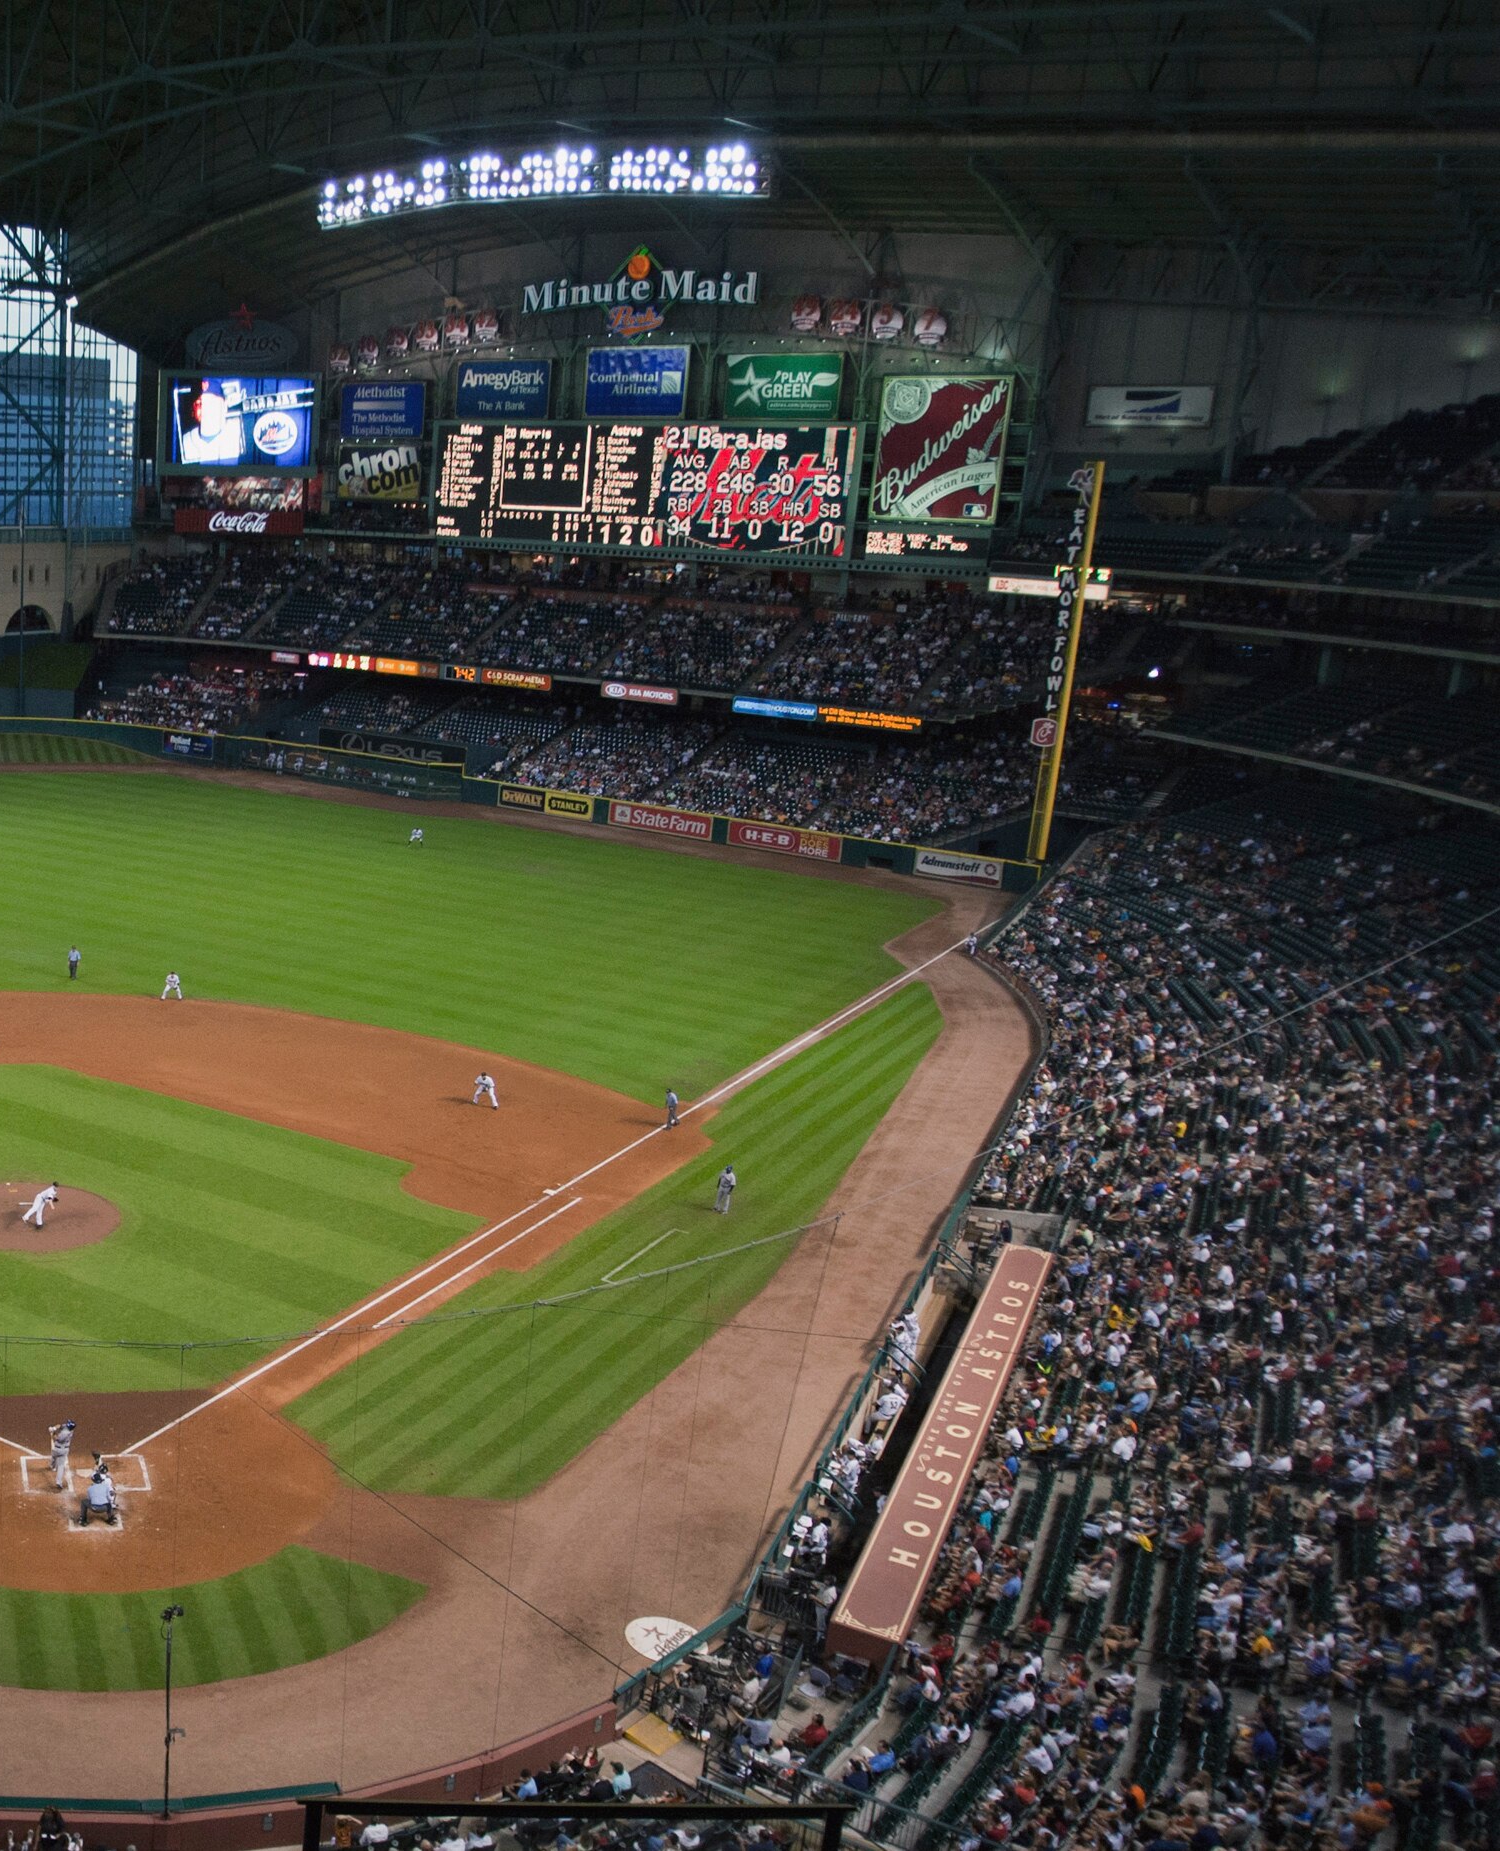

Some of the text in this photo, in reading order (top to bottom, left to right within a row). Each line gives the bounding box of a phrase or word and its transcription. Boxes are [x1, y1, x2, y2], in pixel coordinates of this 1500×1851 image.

[521, 270, 758, 314] Minute Maid
[475, 308, 497, 327] 42
[831, 299, 859, 321] 24
[879, 303, 893, 325] 5
[922, 307, 938, 331] 7
[446, 314, 467, 332] 34
[608, 306, 664, 335] Park
[201, 329, 282, 356] Astros
[462, 369, 544, 393] AmegyBank
[590, 371, 659, 383] Continental
[354, 386, 406, 399] Methodist
[510, 385, 539, 394] of Texas
[612, 383, 657, 395] Airlines
[762, 383, 813, 398] GREEN
[478, 400, 525, 410] The Bank
[352, 413, 405, 423] The Methodist
[352, 426, 412, 437] Hospital System
[460, 424, 483, 436] Mets
[506, 428, 552, 440] 20 Norris
[610, 425, 643, 437] Astros
[666, 428, 787, 450] 21 Barajas
[873, 380, 1008, 512] Budweiser
[338, 447, 417, 486] chron
[673, 455, 838, 471] AVG. AB R H
[717, 472, 755, 494] 246
[768, 474, 795, 496] 30
[813, 475, 841, 497] 56
[909, 478, 958, 513] American
[961, 470, 993, 483] Lager
[667, 498, 840, 518] RBI 2B 3B HR SB
[209, 511, 269, 533] Coca-Cola
[436, 516, 455, 526] Mets
[667, 516, 833, 543] 34 11 0 12 0
[436, 527, 460, 537] Astros
[600, 524, 654, 546] 1 2 0
[1067, 508, 1085, 565] EAT
[1058, 572, 1076, 629] MOR
[453, 667, 475, 682] 7:42
[487, 671, 503, 681] C&D
[505, 672, 525, 683] SCRAP
[526, 675, 546, 686] METAL
[1045, 636, 1067, 711] FOWL
[609, 686, 674, 701] KIA KIA MOTORS
[366, 741, 443, 763] LEXUS
[548, 799, 587, 814] STANLEY
[745, 829, 790, 847] H-E-B
[800, 838, 828, 849] DOES
[798, 846, 828, 858] MORE
[921, 855, 981, 873] Administaff
[924, 1350, 975, 1450] THE HOME OF THE
[888, 1279, 1030, 1569] HOUSTON ASTROS
[654, 1628, 693, 1658] Astros
